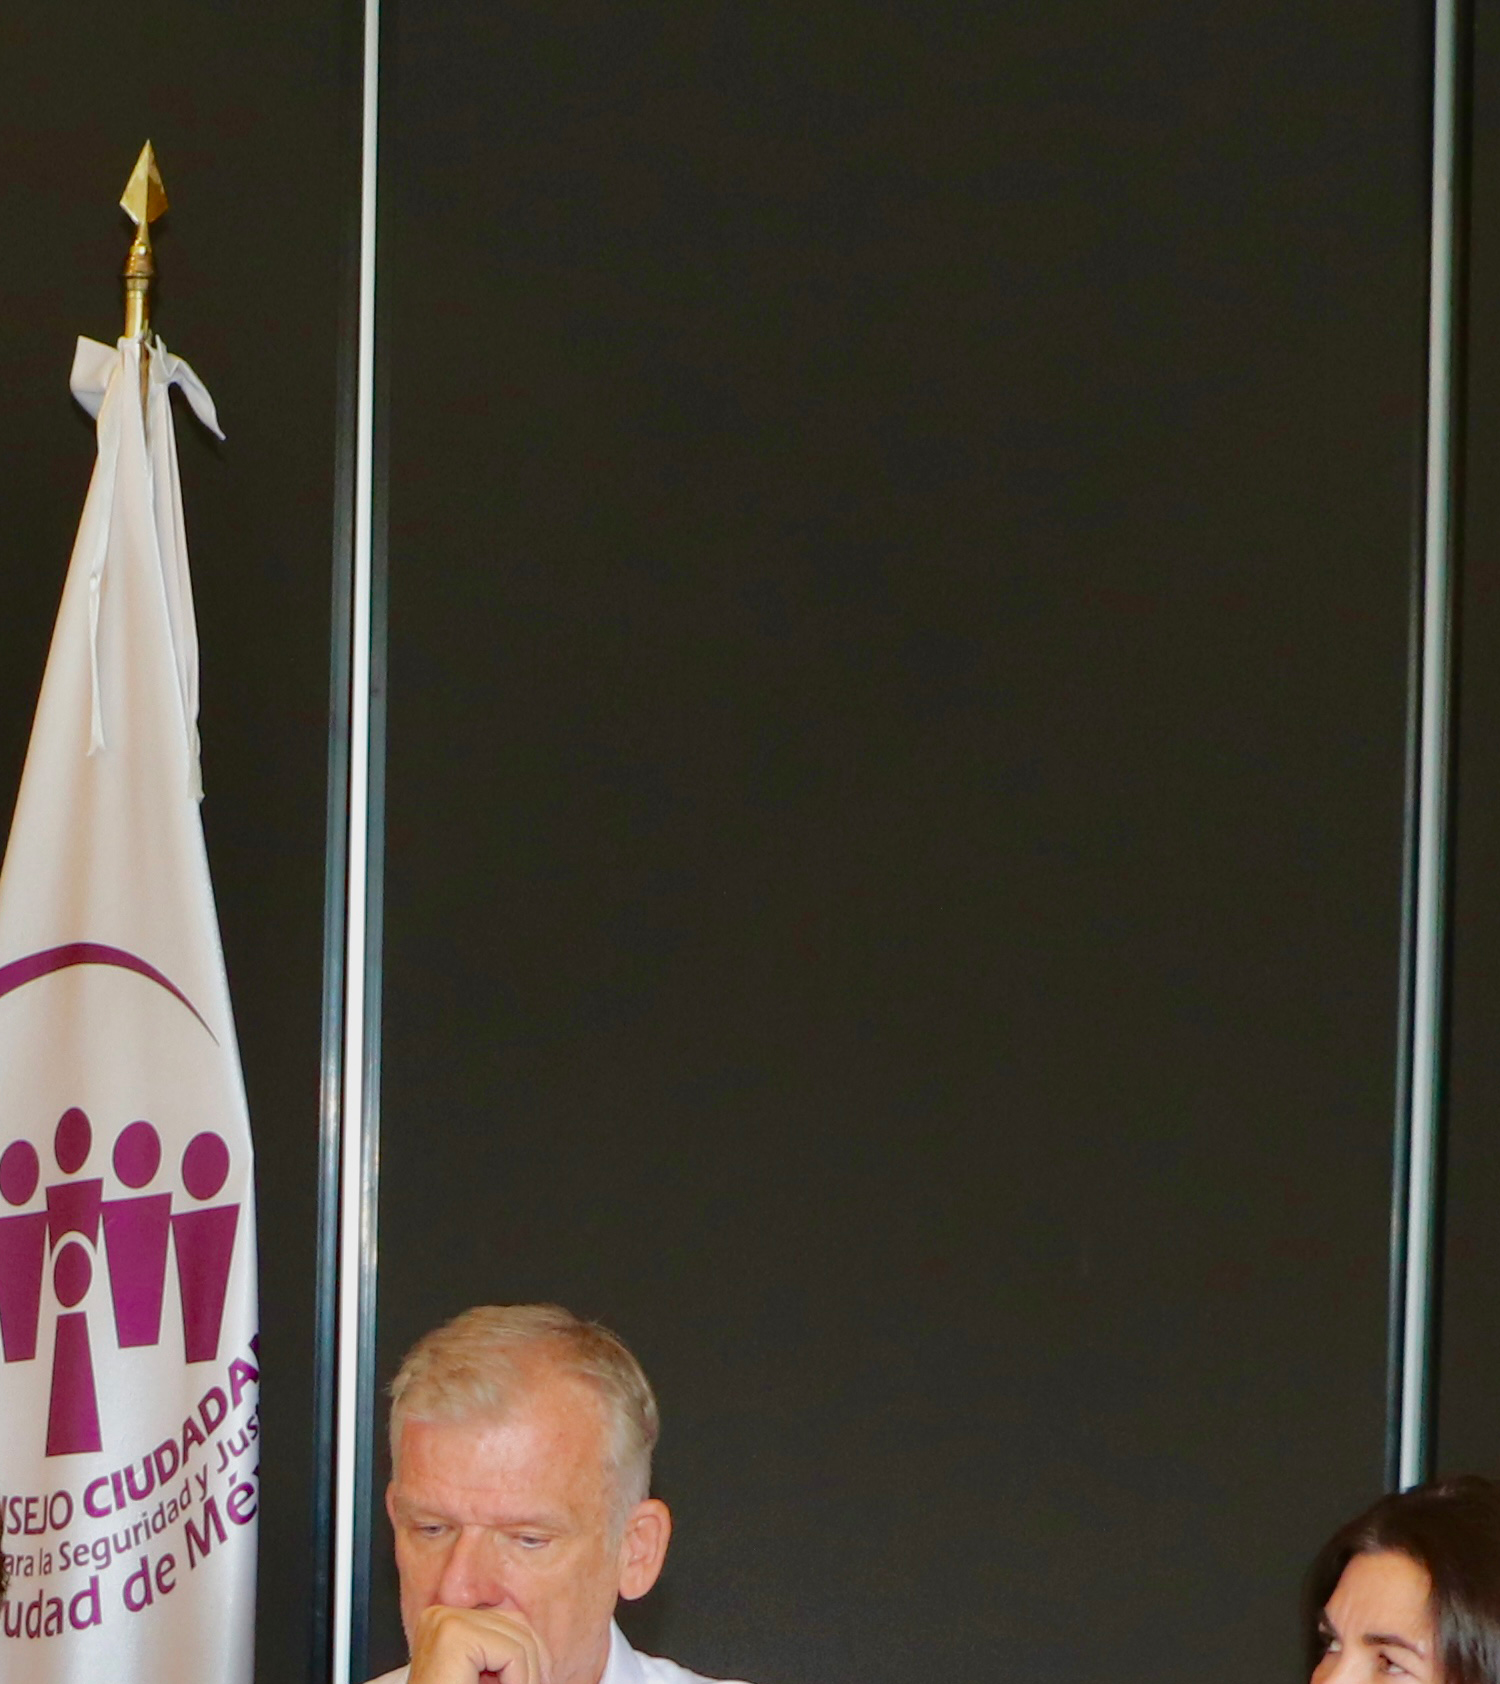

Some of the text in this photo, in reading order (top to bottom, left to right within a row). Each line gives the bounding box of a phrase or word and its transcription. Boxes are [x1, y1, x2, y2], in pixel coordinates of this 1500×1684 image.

[83, 1334, 260, 1518] CIUDADA
[3, 1552, 34, 1577] ara
[39, 1548, 52, 1576] la
[59, 1478, 193, 1571] Seguridad
[195, 1464, 208, 1500] y
[123, 1554, 176, 1613] de
